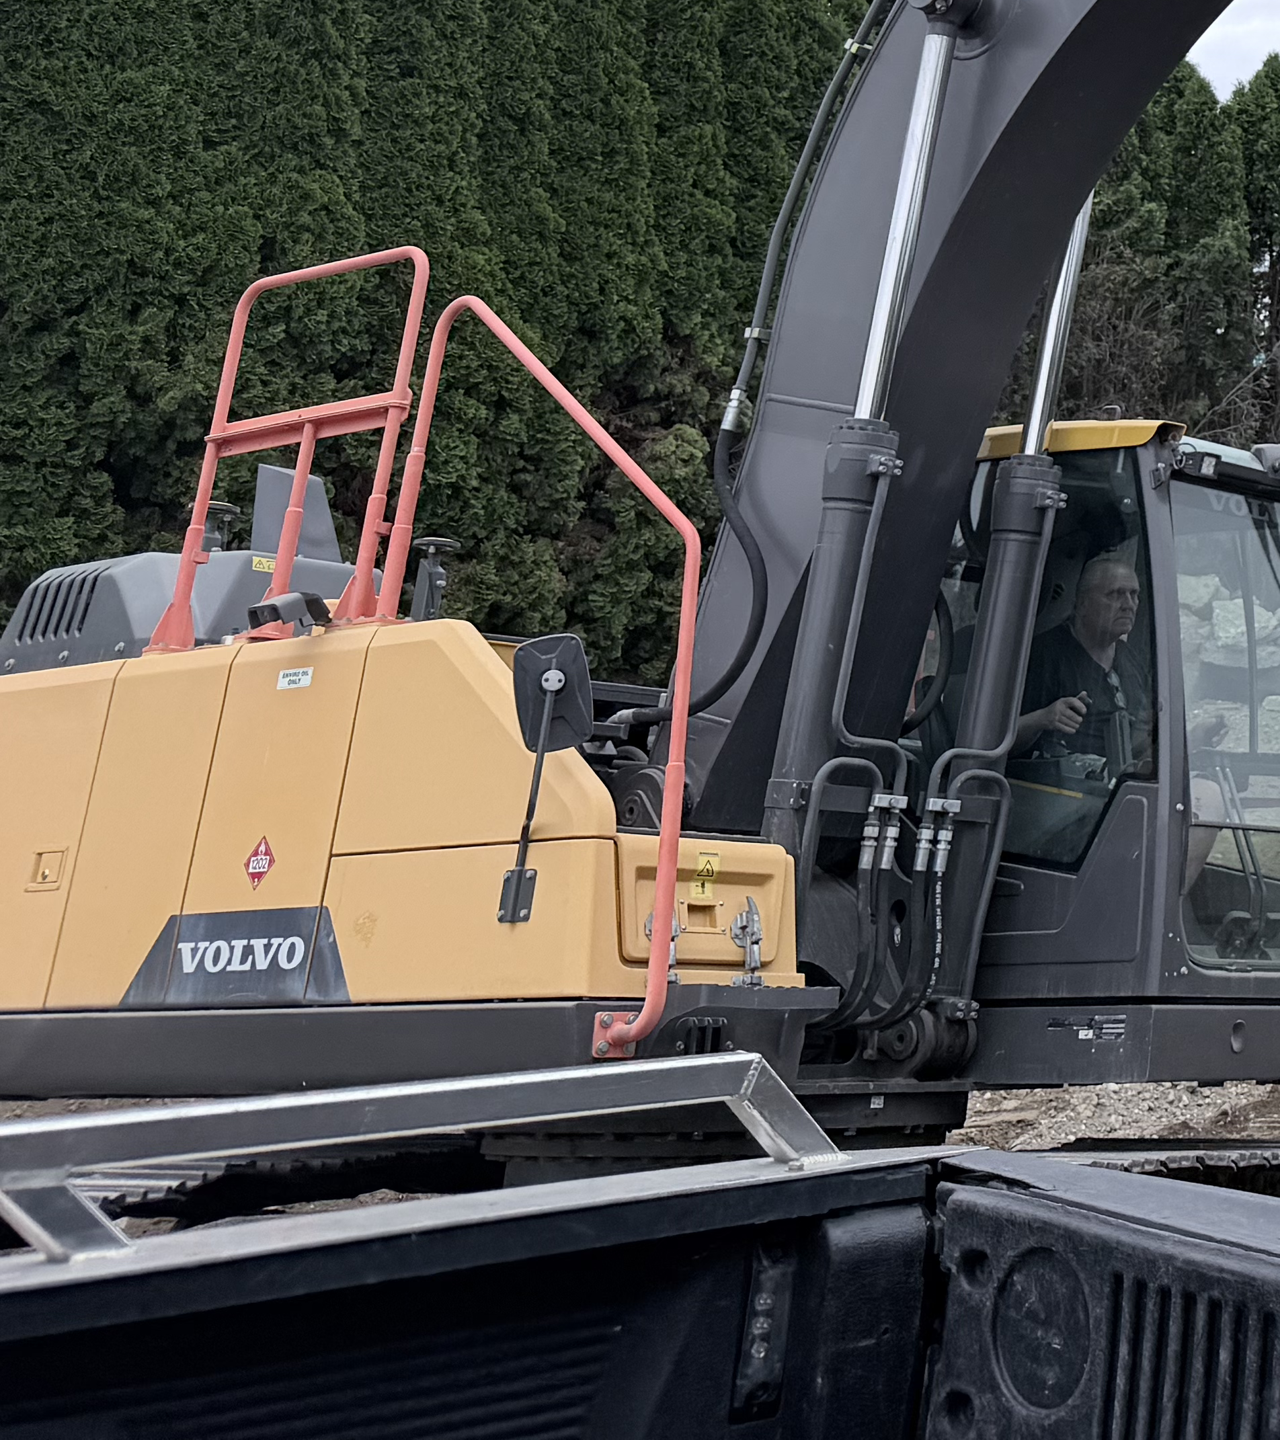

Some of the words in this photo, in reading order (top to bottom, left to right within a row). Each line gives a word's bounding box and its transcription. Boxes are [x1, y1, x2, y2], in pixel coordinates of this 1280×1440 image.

[287, 678, 302, 686] ONLY
[251, 857, 268, 871] 1202
[177, 935, 305, 974] VOLVO
